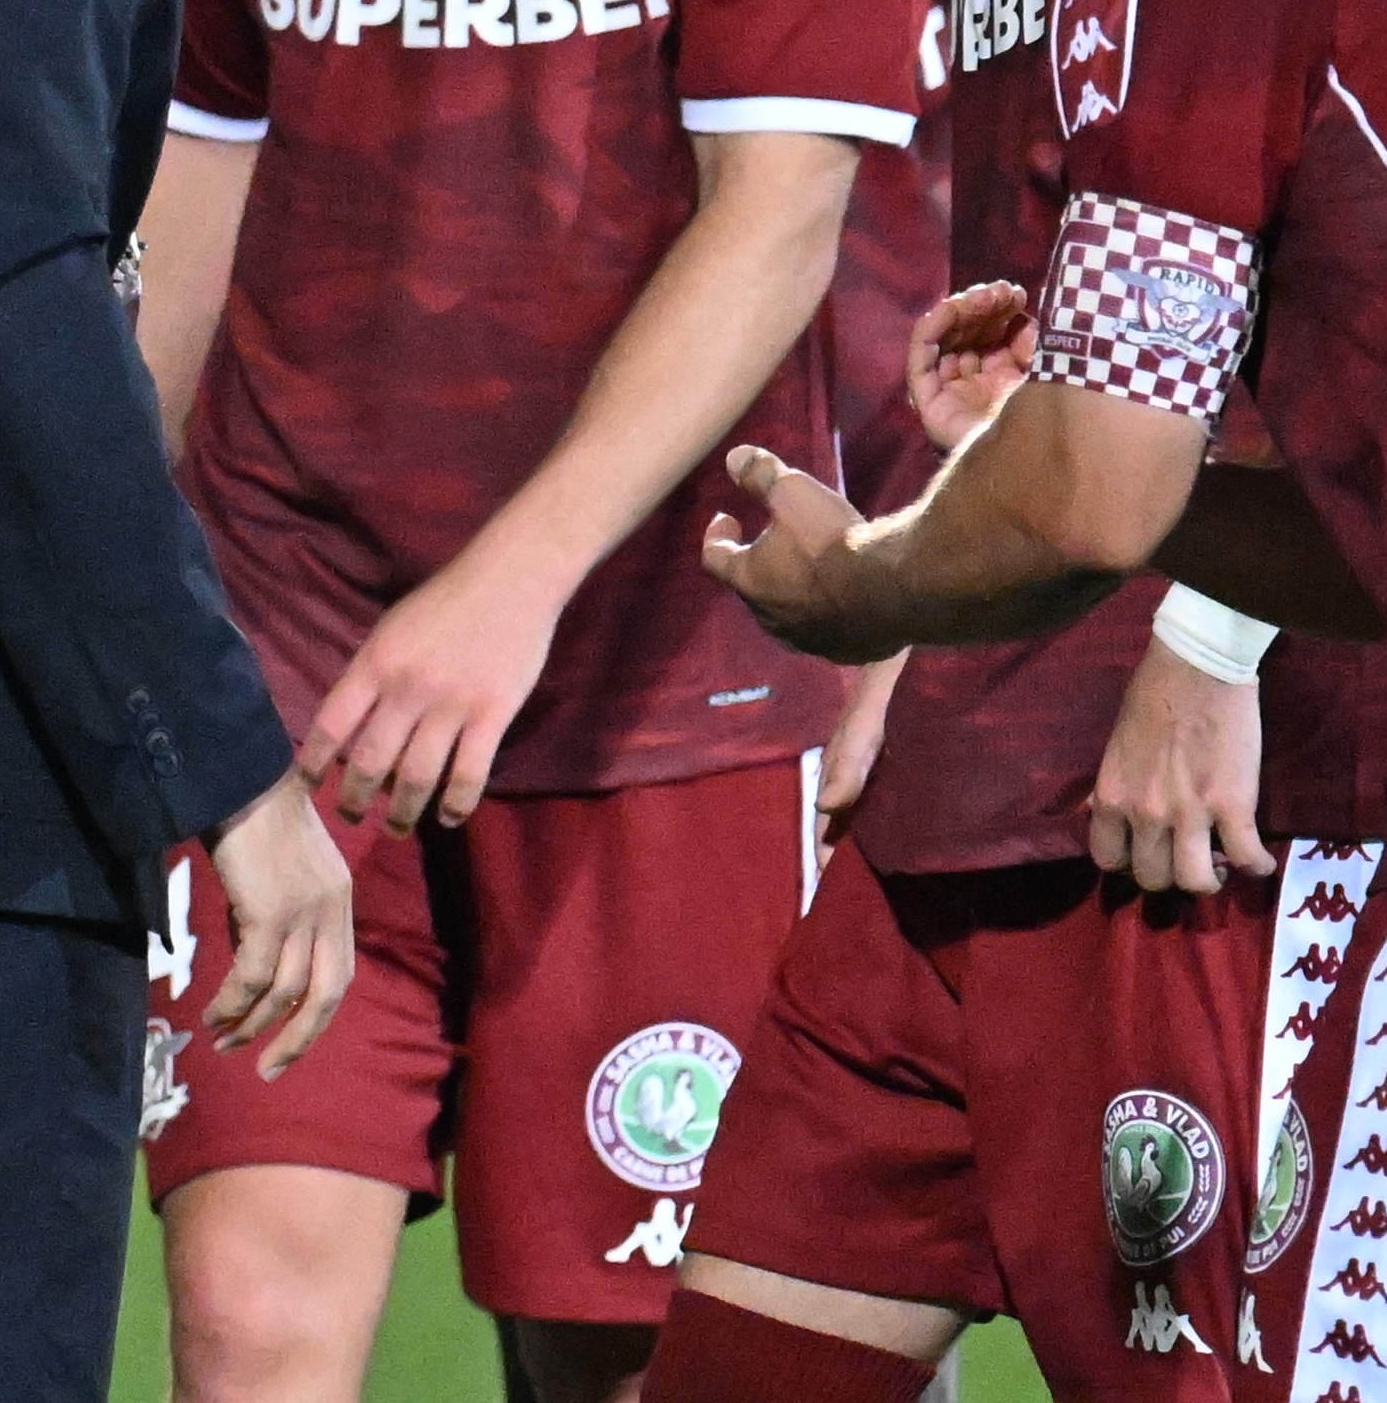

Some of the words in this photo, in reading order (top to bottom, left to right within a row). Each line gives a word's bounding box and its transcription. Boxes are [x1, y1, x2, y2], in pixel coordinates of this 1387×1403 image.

[1159, 268, 1218, 295] RAPID
[1142, 1096, 1158, 1118] &
[1166, 1104, 1210, 1160] VLAD
